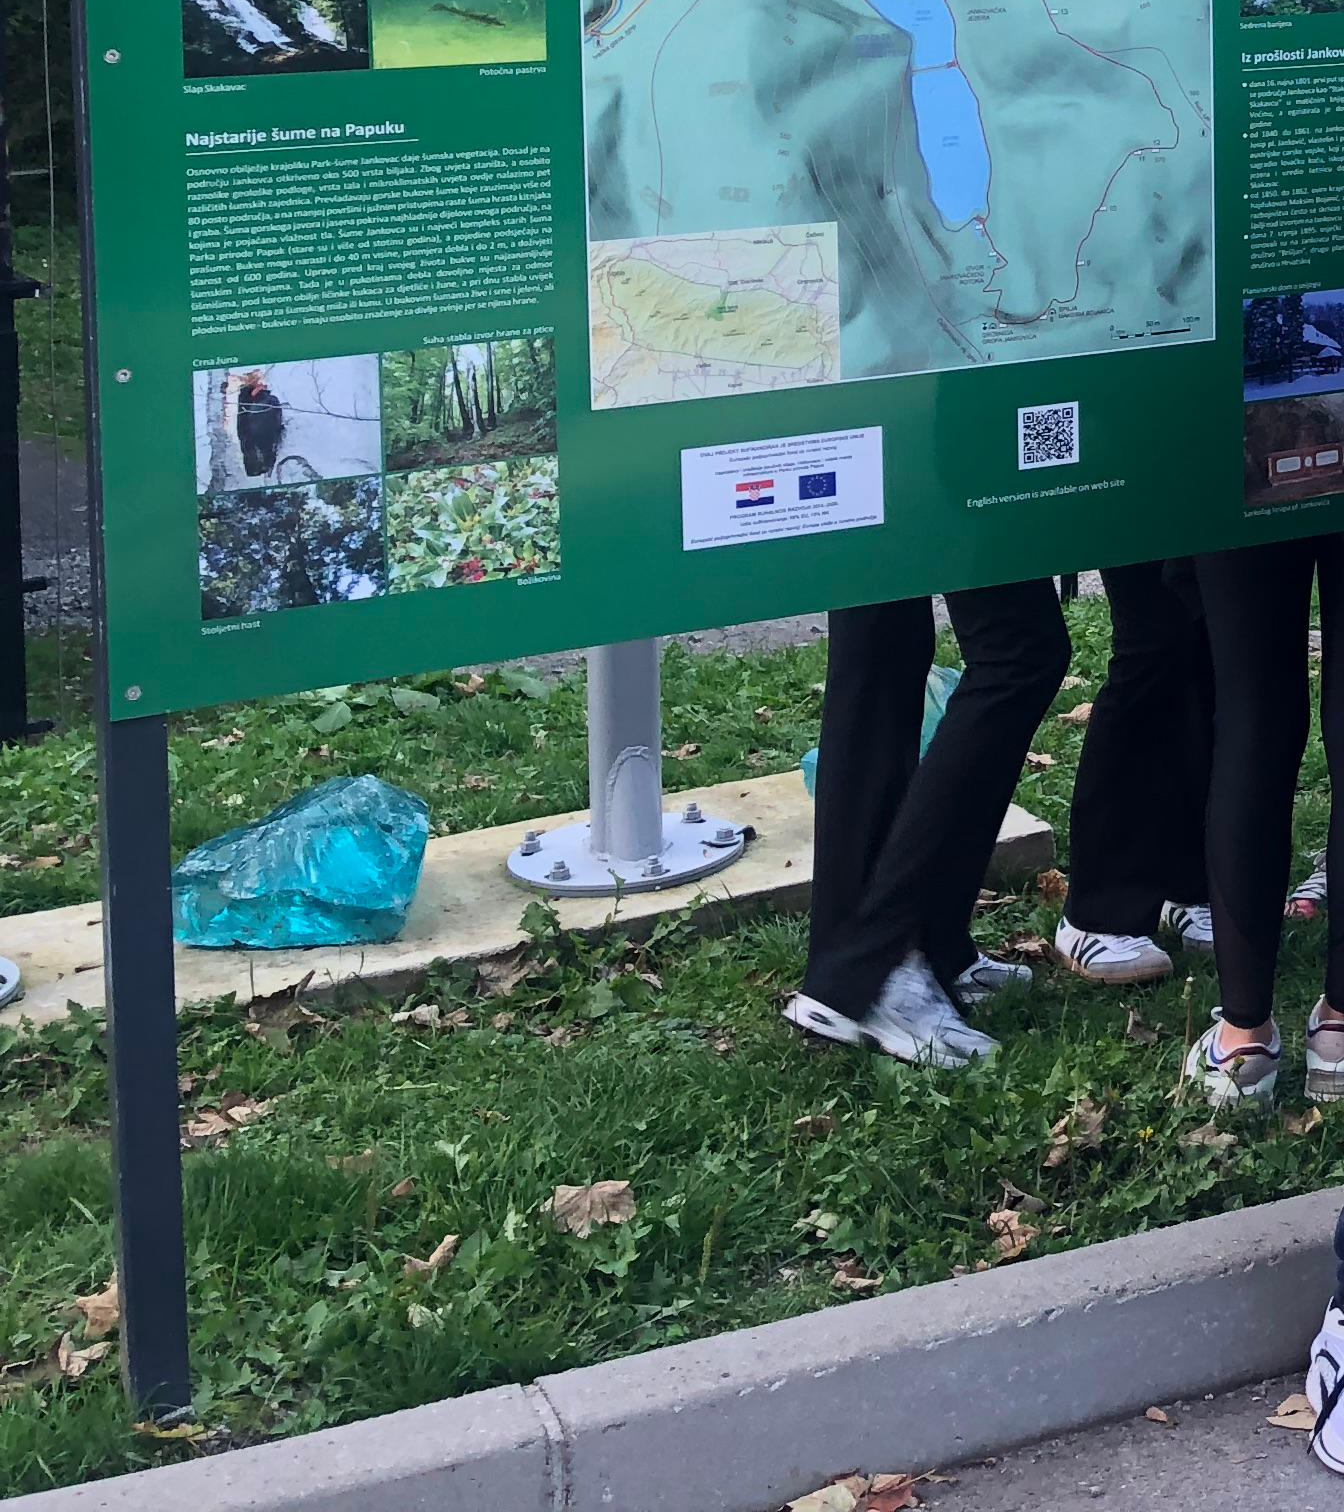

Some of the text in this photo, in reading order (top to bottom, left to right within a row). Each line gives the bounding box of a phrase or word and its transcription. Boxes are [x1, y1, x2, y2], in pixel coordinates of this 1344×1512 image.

[1241, 52, 1251, 63] Iz
[1254, 48, 1304, 65] prošlosti
[480, 67, 546, 75] Potočna pastrva
[183, 84, 246, 94] Slap Skakavac
[186, 121, 404, 148] Najstarije šume na Papuku
[186, 168, 228, 177] Osnovno
[311, 158, 358, 168] Park-šume
[401, 154, 420, 163] daje
[422, 150, 453, 160] šumska
[456, 149, 500, 159] vegetacija.
[502, 146, 528, 156] Dosad
[530, 146, 538, 155] je
[423, 336, 444, 345] Suha
[447, 333, 472, 343] stabla
[474, 331, 494, 340] izvor
[496, 329, 520, 337] hrane
[533, 326, 554, 335] ptice
[192, 357, 238, 367] Crna žuna
[967, 496, 998, 508] English
[999, 492, 1031, 503] version
[1040, 486, 1077, 497] available
[1079, 483, 1090, 492] on
[1091, 480, 1109, 489] web
[1110, 479, 1125, 487] site
